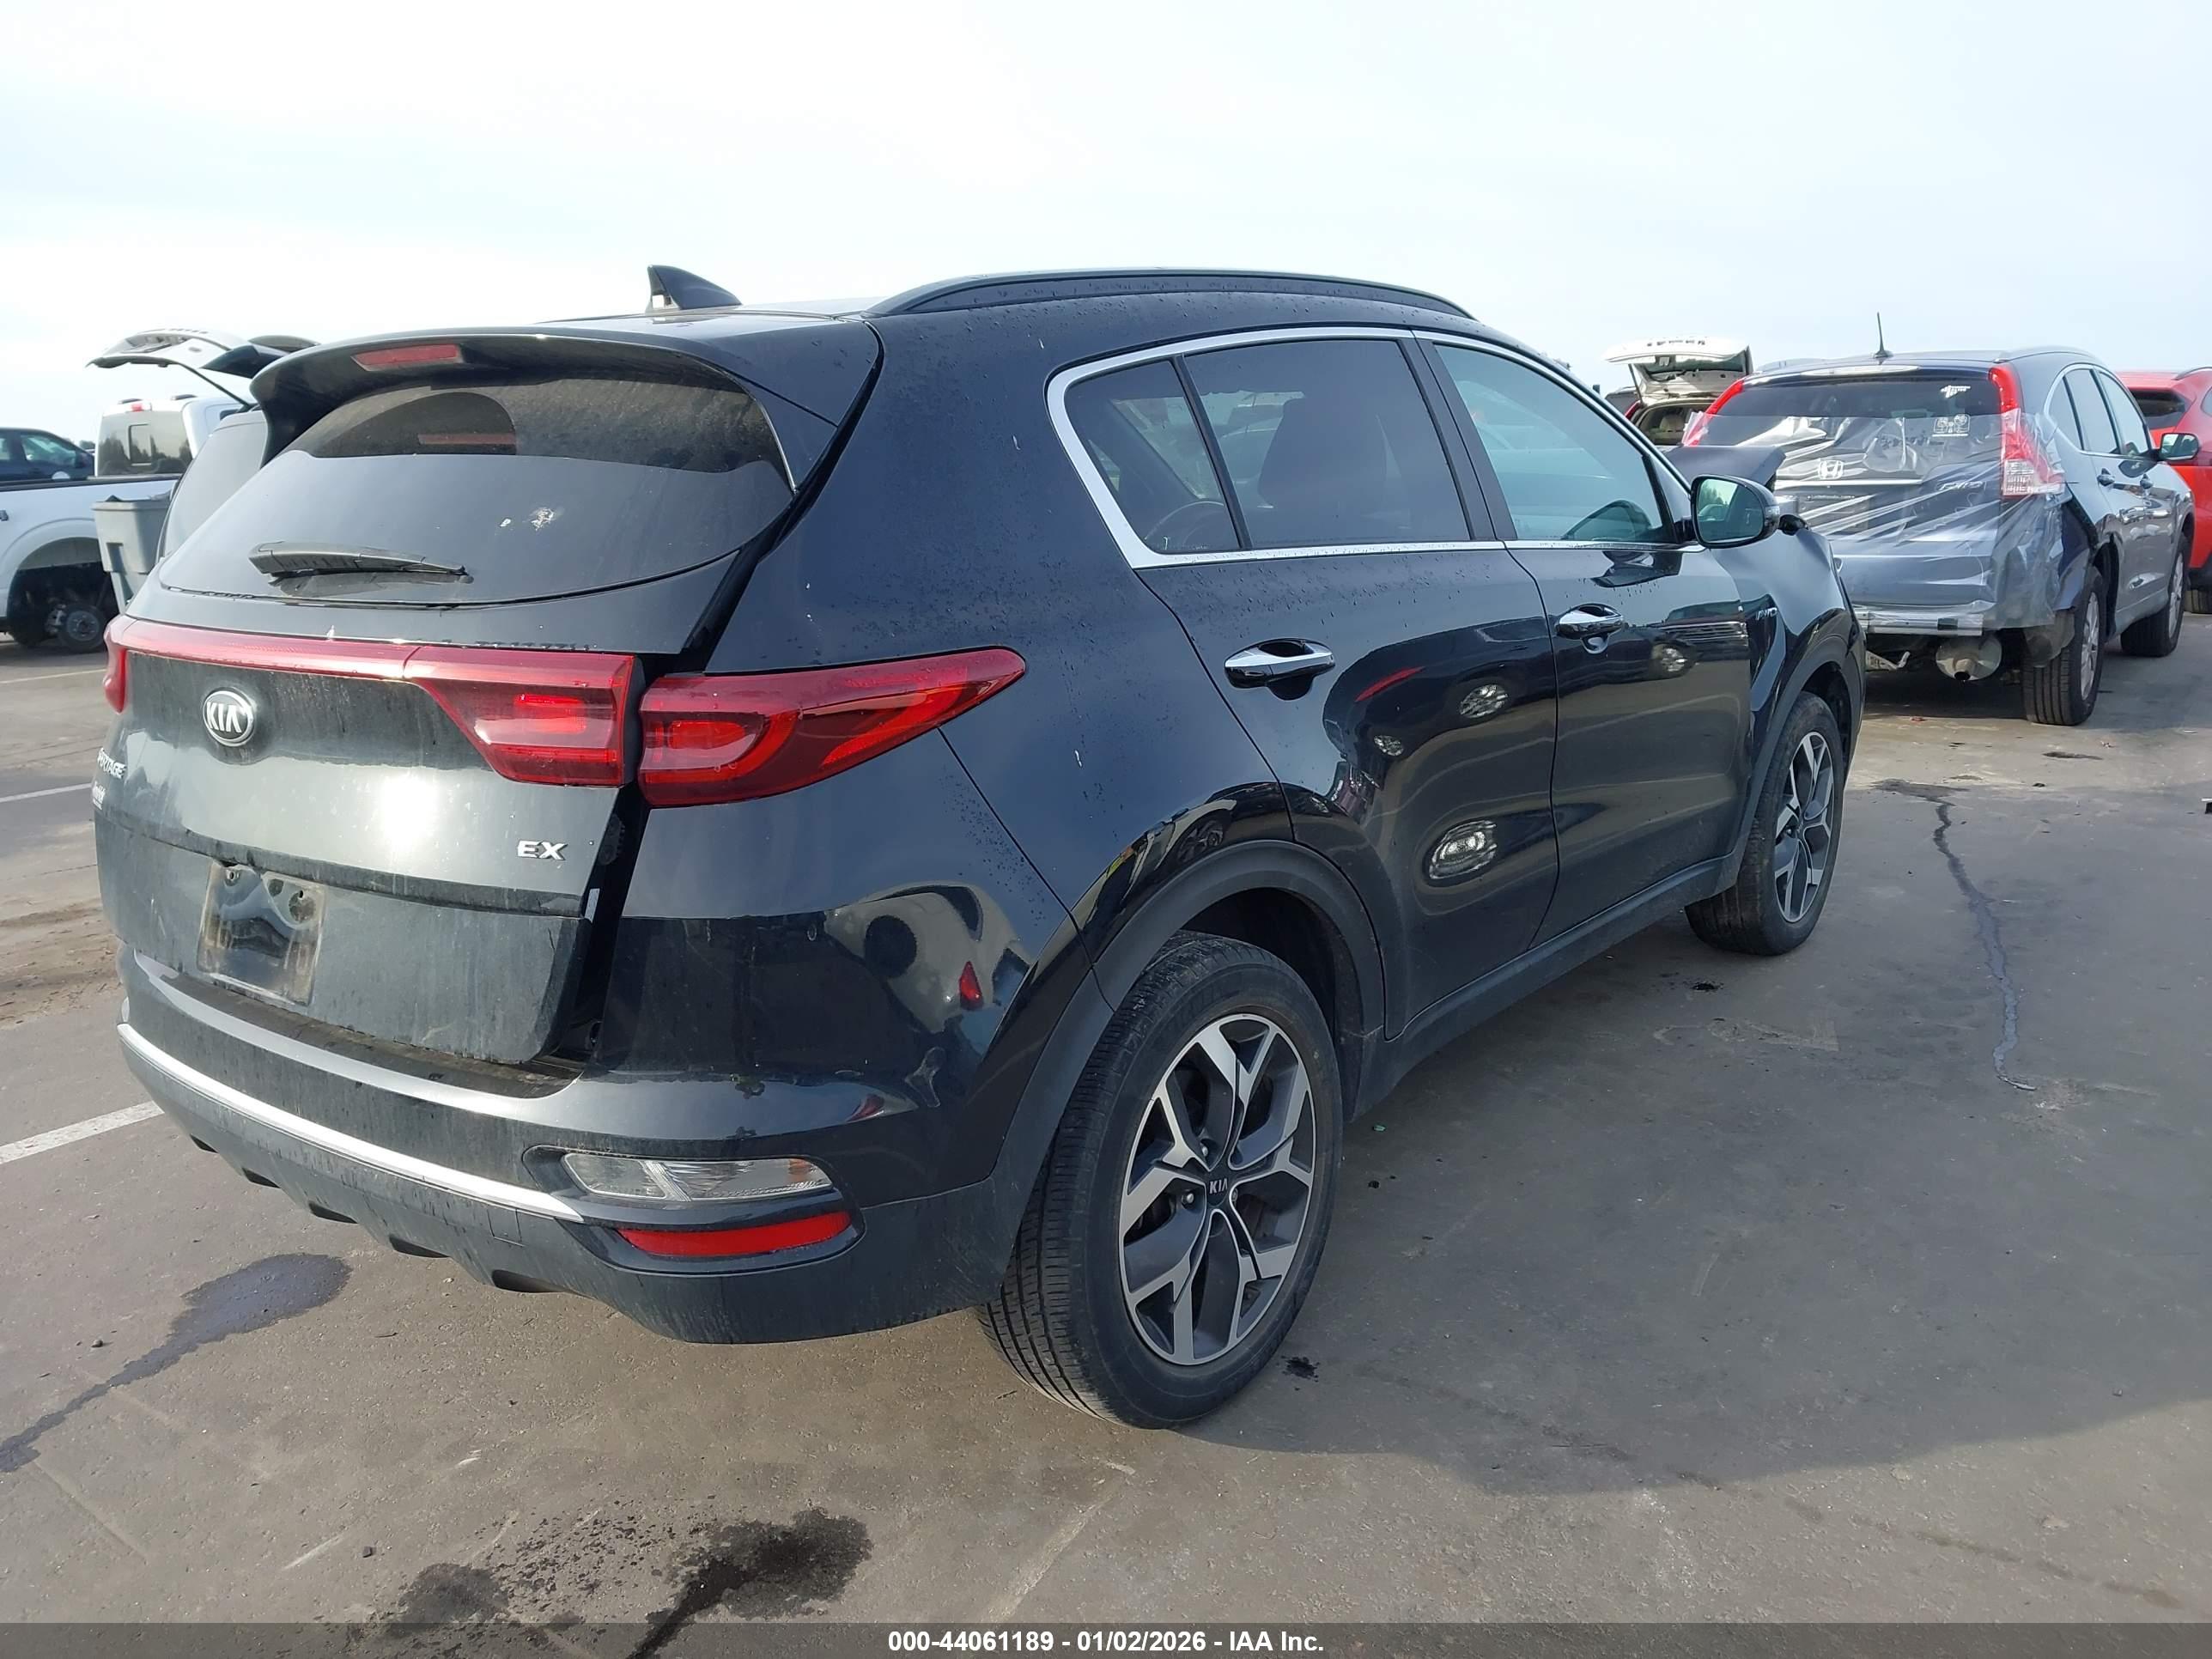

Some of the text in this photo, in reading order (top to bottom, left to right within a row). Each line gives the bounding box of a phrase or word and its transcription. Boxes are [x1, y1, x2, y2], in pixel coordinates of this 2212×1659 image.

[206, 701, 242, 733] KIA
[517, 840, 568, 860] EX
[1209, 1177, 1228, 1194] KIA
